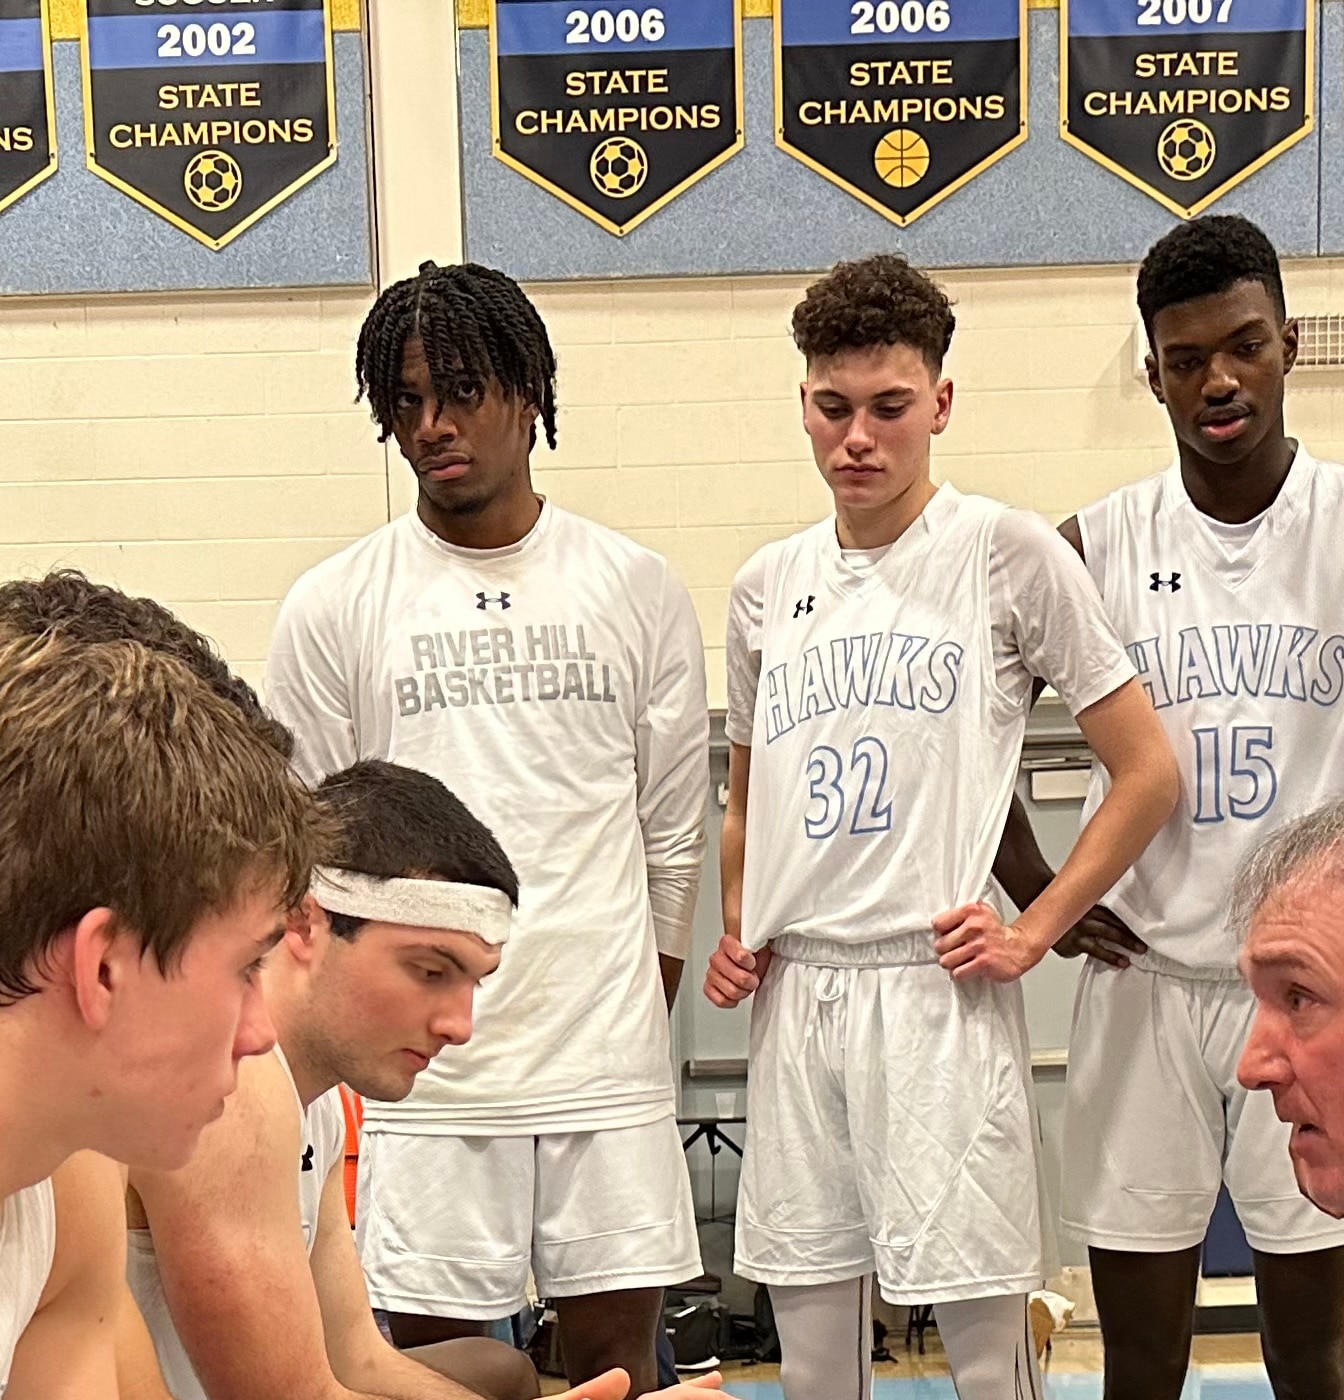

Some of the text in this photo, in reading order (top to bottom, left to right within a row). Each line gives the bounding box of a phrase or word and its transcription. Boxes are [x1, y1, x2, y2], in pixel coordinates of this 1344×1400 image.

[567, 9, 664, 43] 2006
[851, 0, 949, 33] 2006
[158, 23, 255, 56] 2002
[851, 60, 952, 85] STATE
[1136, 52, 1238, 77] STATE
[159, 83, 260, 108] STATE
[567, 70, 668, 95] STATE
[799, 96, 1004, 124] CHAMPIONS
[1085, 87, 1289, 115] CHAMPIONS
[110, 119, 313, 148] CHAMPIONS
[516, 105, 720, 134] CHAMPIONS
[411, 624, 596, 671] RIVER HILL
[394, 662, 616, 717] BASKETBALL
[766, 632, 964, 745] HAWKS
[804, 736, 892, 839] 32
[1192, 726, 1277, 823] 15
